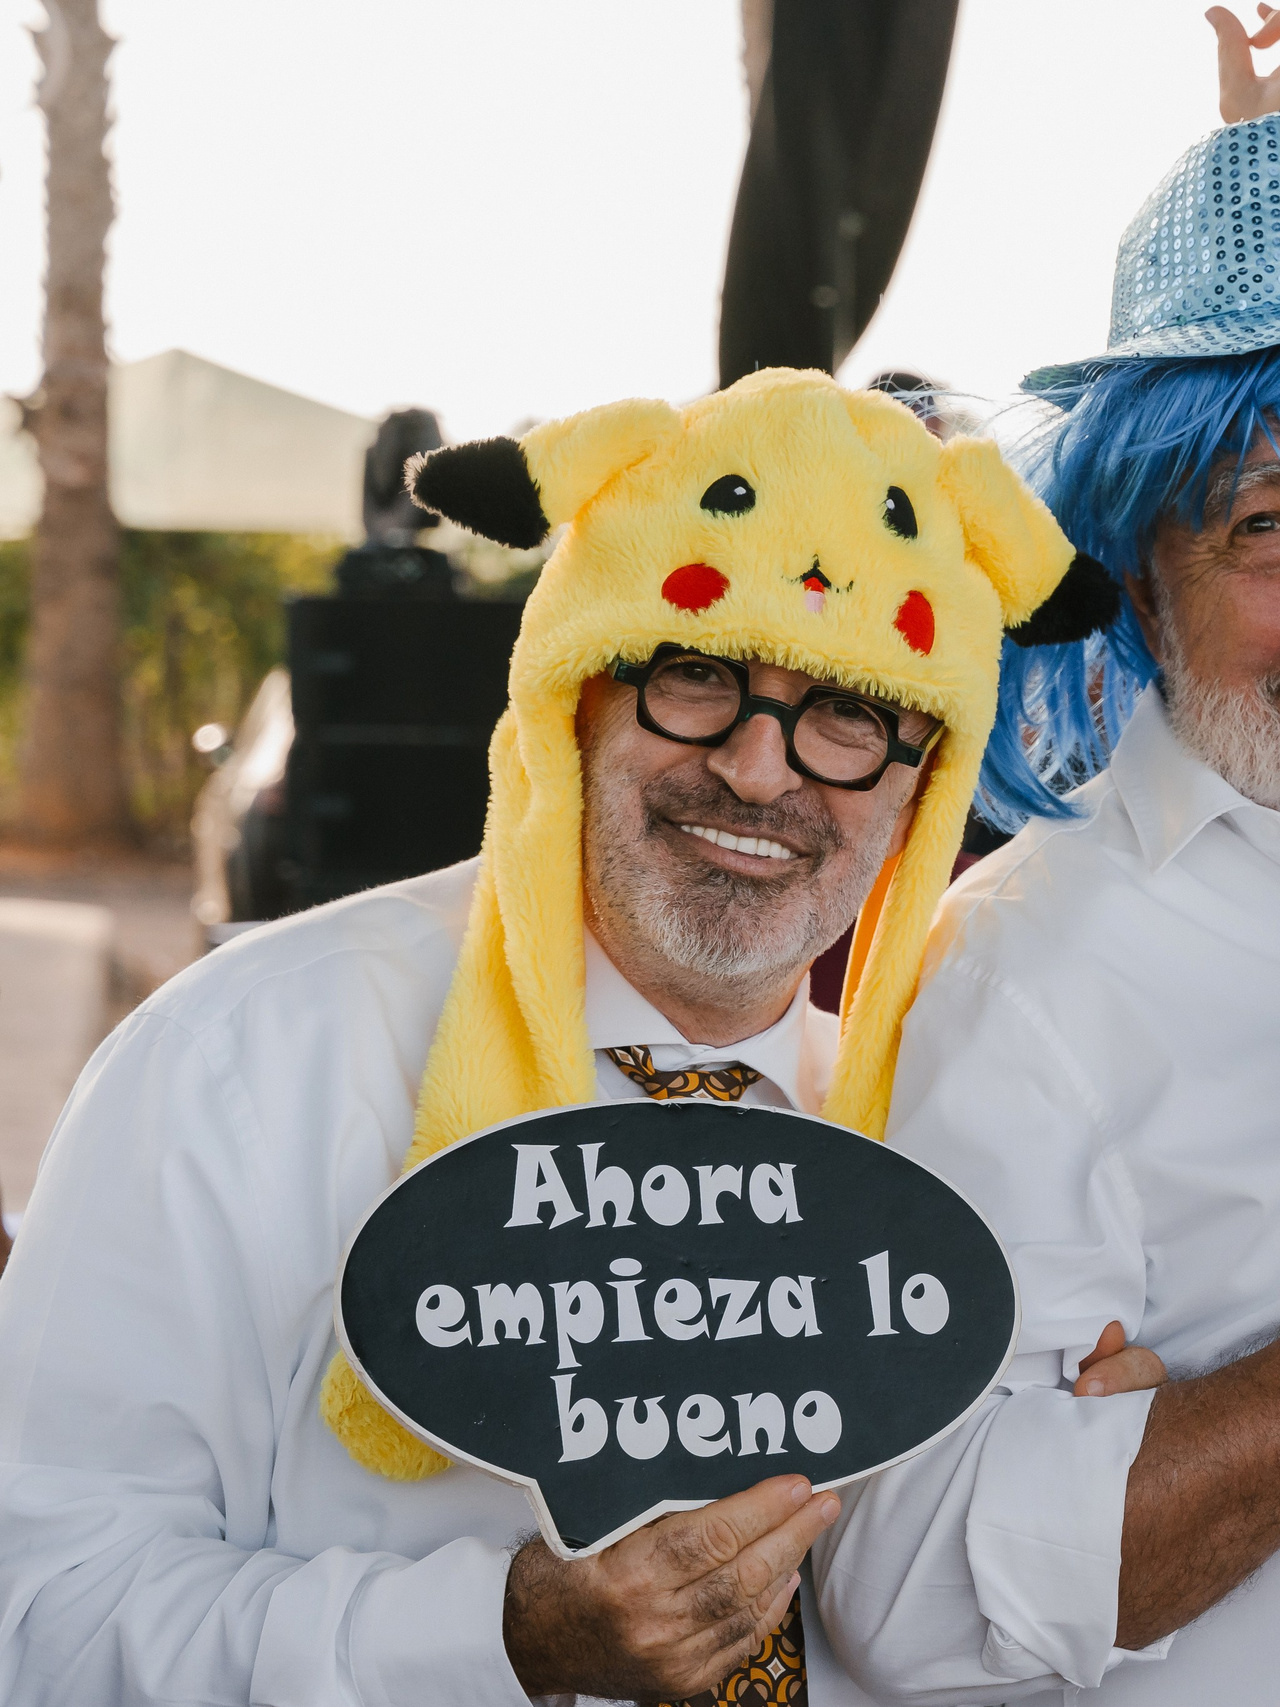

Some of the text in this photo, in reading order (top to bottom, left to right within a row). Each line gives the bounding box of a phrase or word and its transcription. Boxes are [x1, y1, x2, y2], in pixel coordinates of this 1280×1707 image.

[504, 1142, 804, 1229] Ahora
[415, 1250, 950, 1369] empieza lo
[550, 1374, 843, 1463] bueno
